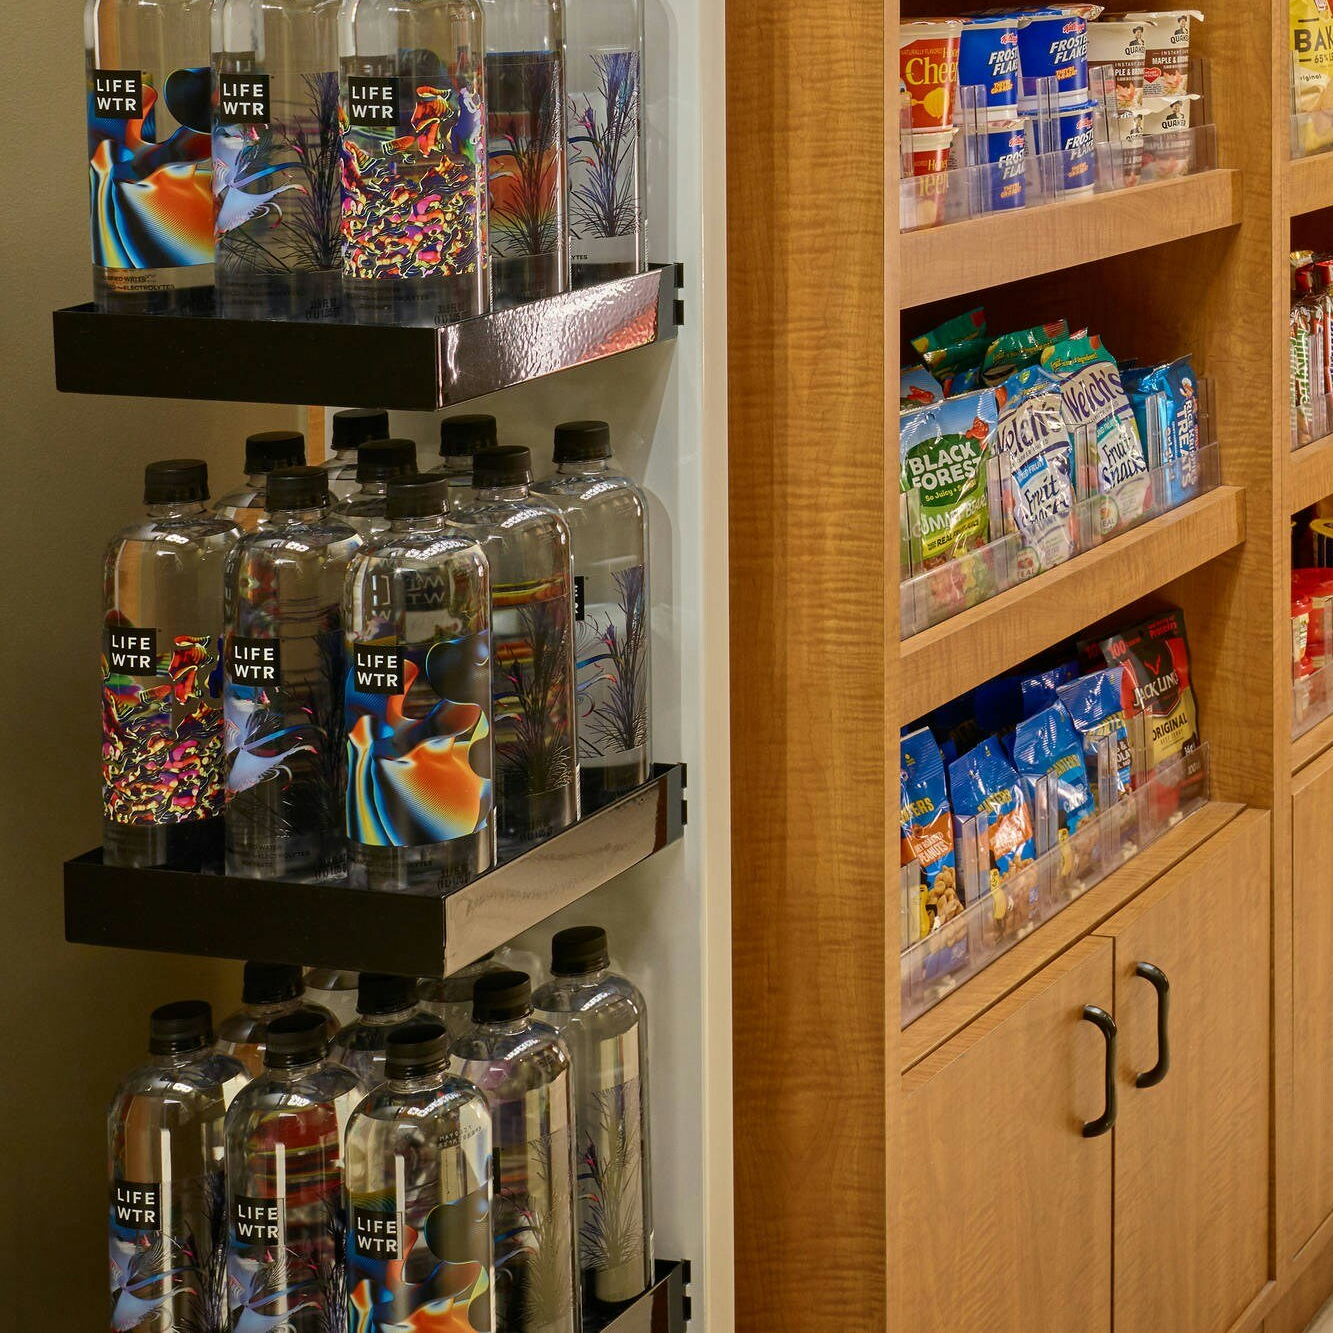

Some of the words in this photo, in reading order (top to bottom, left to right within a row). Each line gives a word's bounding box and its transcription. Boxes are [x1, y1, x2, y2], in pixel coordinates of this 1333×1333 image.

[1152, 56, 1172, 65] MAPLE
[96, 79, 135, 93] LIFE
[1300, 74, 1322, 82] riginal
[223, 83, 264, 97] LIFE
[352, 86, 393, 100] LIFE
[97, 97, 137, 112] WTR
[223, 101, 264, 116] WTR
[352, 104, 393, 119] WTR
[1062, 369, 1126, 425] Welch's
[908, 442, 976, 476] BLACK
[912, 456, 982, 491] FOREST
[112, 635, 150, 650] LIFE
[112, 653, 150, 668] WTR
[234, 645, 274, 661] LIFE
[357, 652, 398, 668] LIFE
[234, 664, 275, 680] WTR
[357, 671, 398, 687] WTR
[1134, 681, 1160, 708] JACK
[1152, 713, 1188, 741] ORIGINAL
[919, 843, 948, 865] PEANUTS
[117, 1187, 155, 1205] LIFE
[118, 1206, 155, 1223] WTR
[238, 1204, 278, 1220] LIFE
[238, 1222, 280, 1239] WTR
[357, 1217, 397, 1234] LIFE
[357, 1235, 397, 1252] WTR
